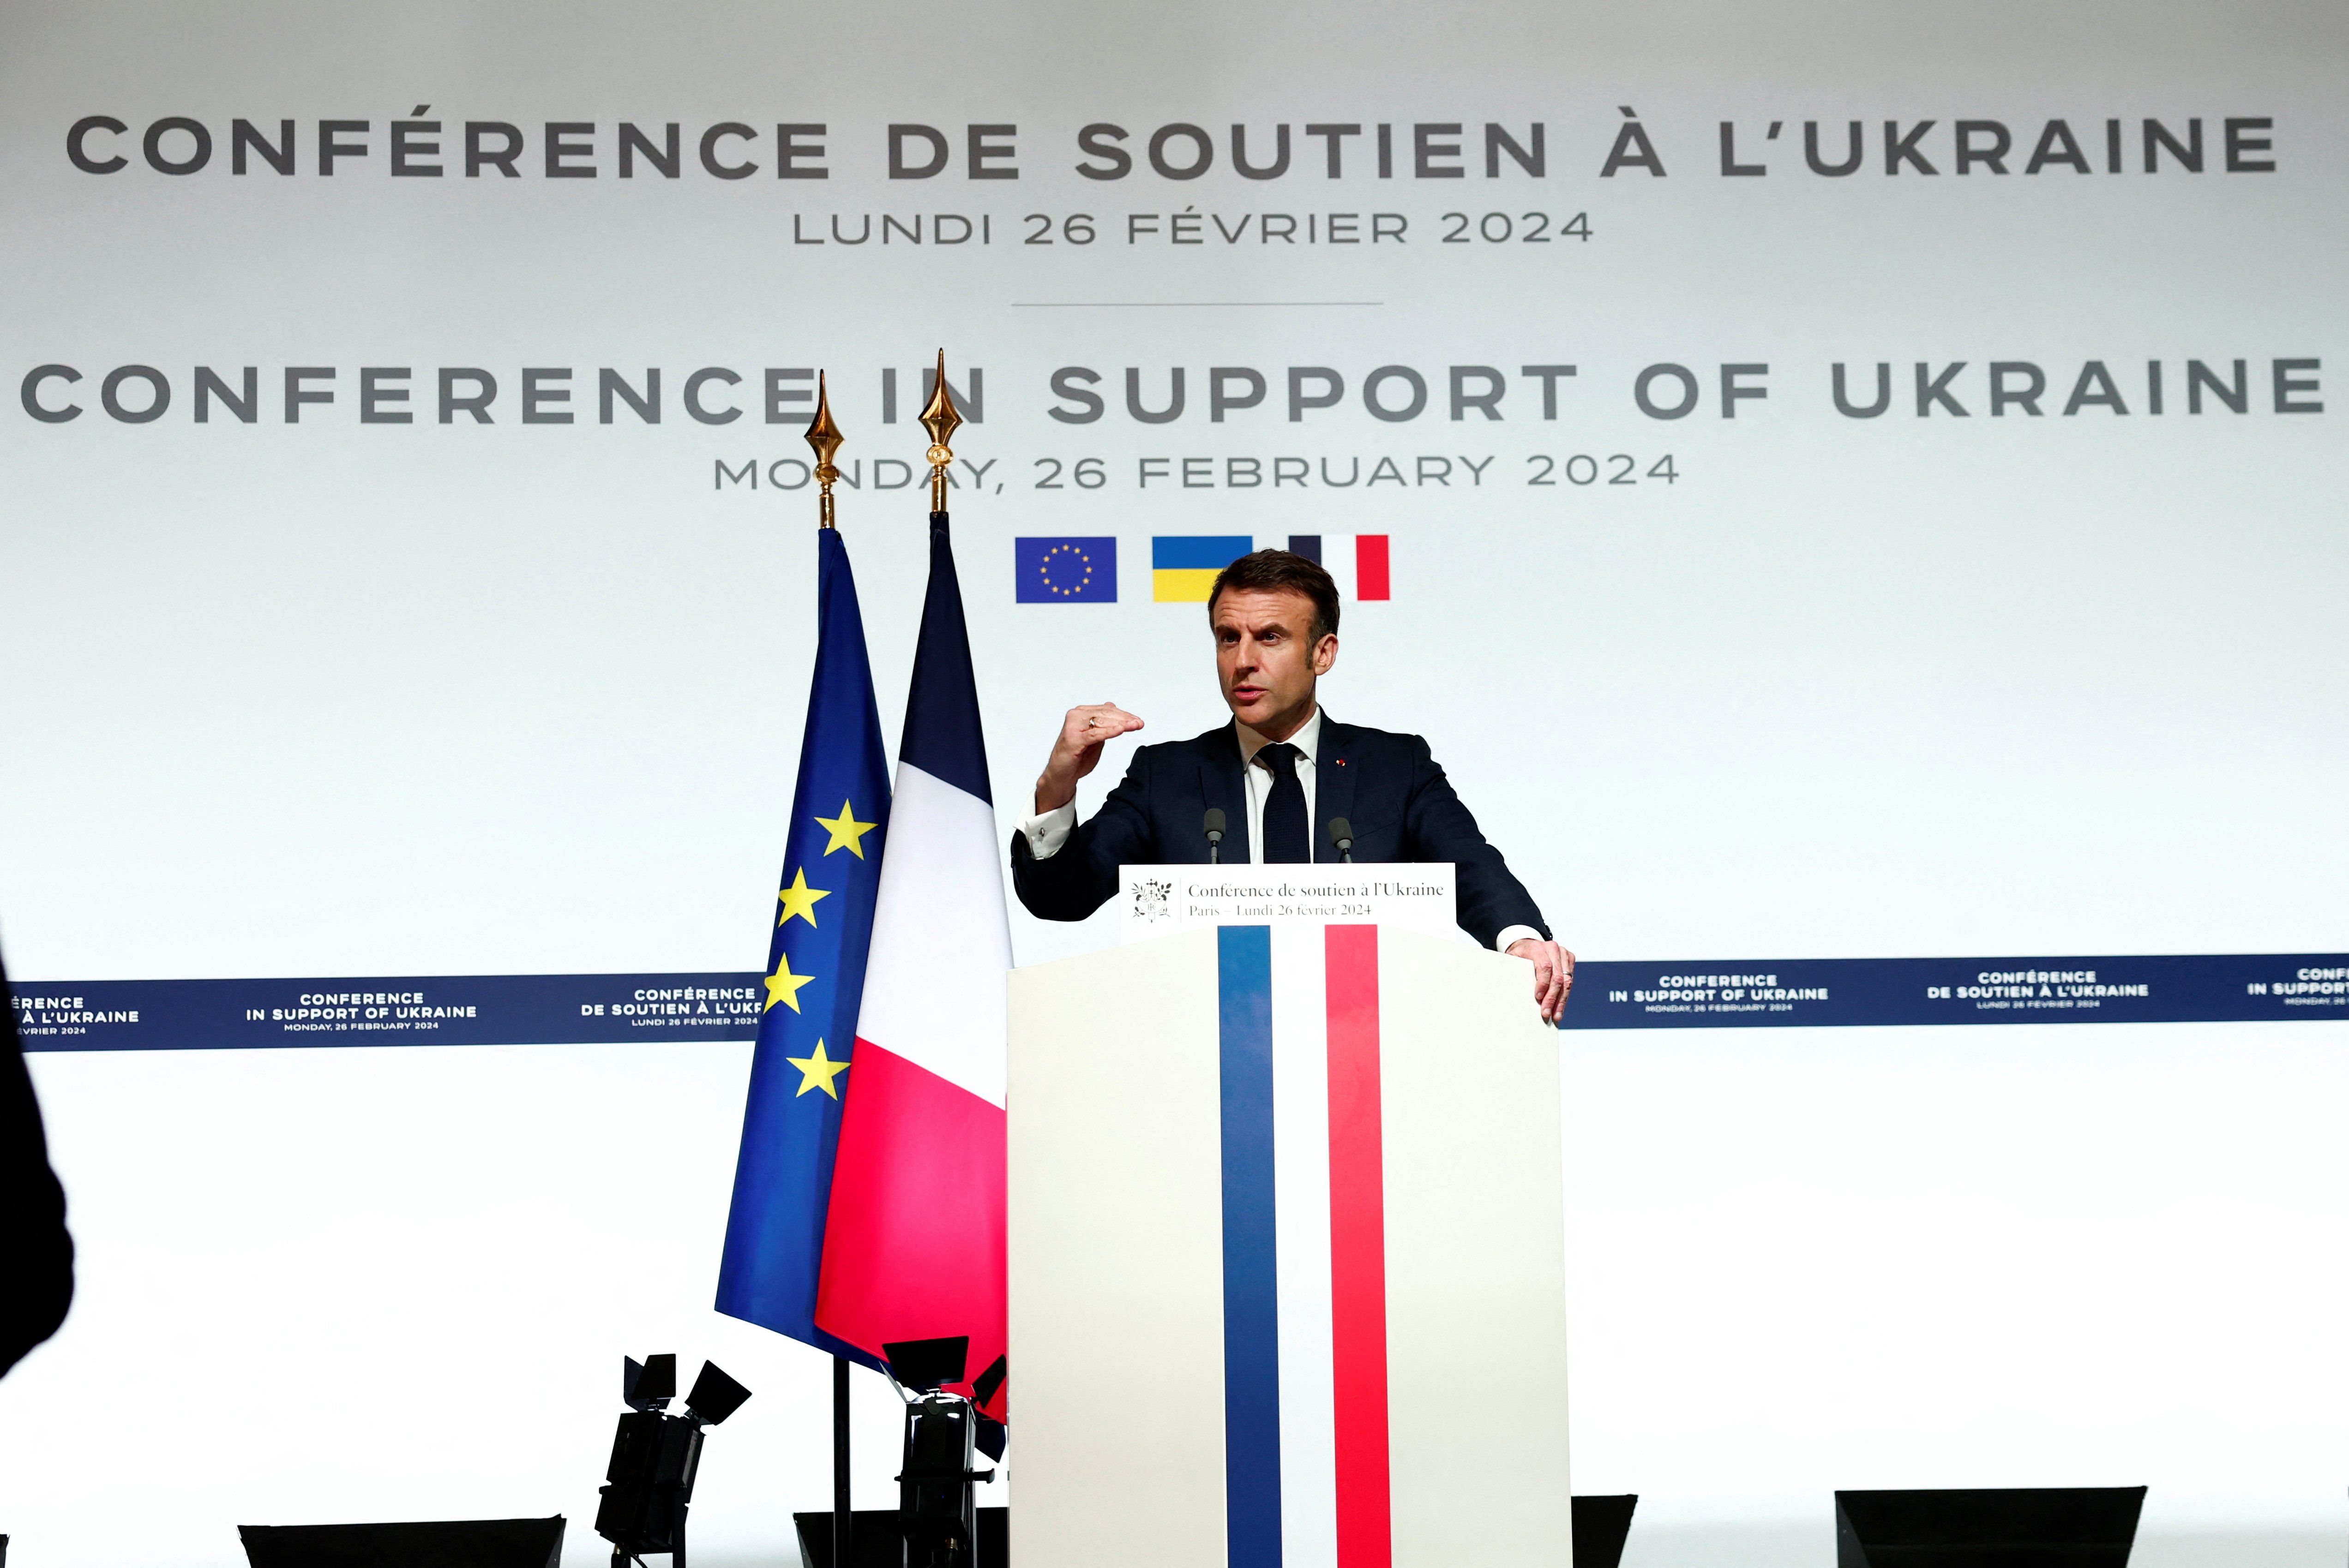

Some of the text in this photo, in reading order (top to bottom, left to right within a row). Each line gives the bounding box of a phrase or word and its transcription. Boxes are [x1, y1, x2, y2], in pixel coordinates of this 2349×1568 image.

[66, 105, 2276, 180] CONFÉRENCE DE SOUTIEN À L'UKRAINE
[794, 205, 1593, 245] LUNDI 26 FÉVRIER 2024
[20, 358, 2324, 425] CONFERENCE IN SUPPORT OF UKRAINE
[715, 454, 1679, 495] MONDAY, 26 FEBRUARY 2024
[1189, 882, 1444, 897] Conférence de soutien à l'Ukraine
[1189, 904, 1220, 916] Paris
[1237, 904, 1273, 916] Lundi
[1278, 904, 1293, 916] 26
[1297, 904, 1336, 916] février
[1341, 904, 1371, 916] 2024
[1659, 975, 1777, 987] CONFERENCE
[1977, 970, 2097, 984] CONFÉRENCE
[2297, 968, 2349, 981] CONF
[634, 987, 755, 1001] CONFÉRENCE
[1610, 988, 1828, 1002] IN SUPPORT OF UKRAINE
[1927, 983, 2149, 999] DE SOUTIEN À L'UKRAINE
[2247, 983, 2267, 995] IN
[12, 996, 84, 1009] ÉRENCE
[300, 992, 423, 1006] CONFERENCE
[246, 1006, 476, 1021] IN SUPPORT OF UKRAINE
[581, 1004, 604, 1016] DE
[612, 1003, 690, 1016] SOUTIEN
[697, 1000, 709, 1014] À
[22, 1010, 139, 1023] À L'UKRAINE
[684, 1017, 731, 1025] FÉVRIER
[284, 1023, 333, 1032] MONDAY,
